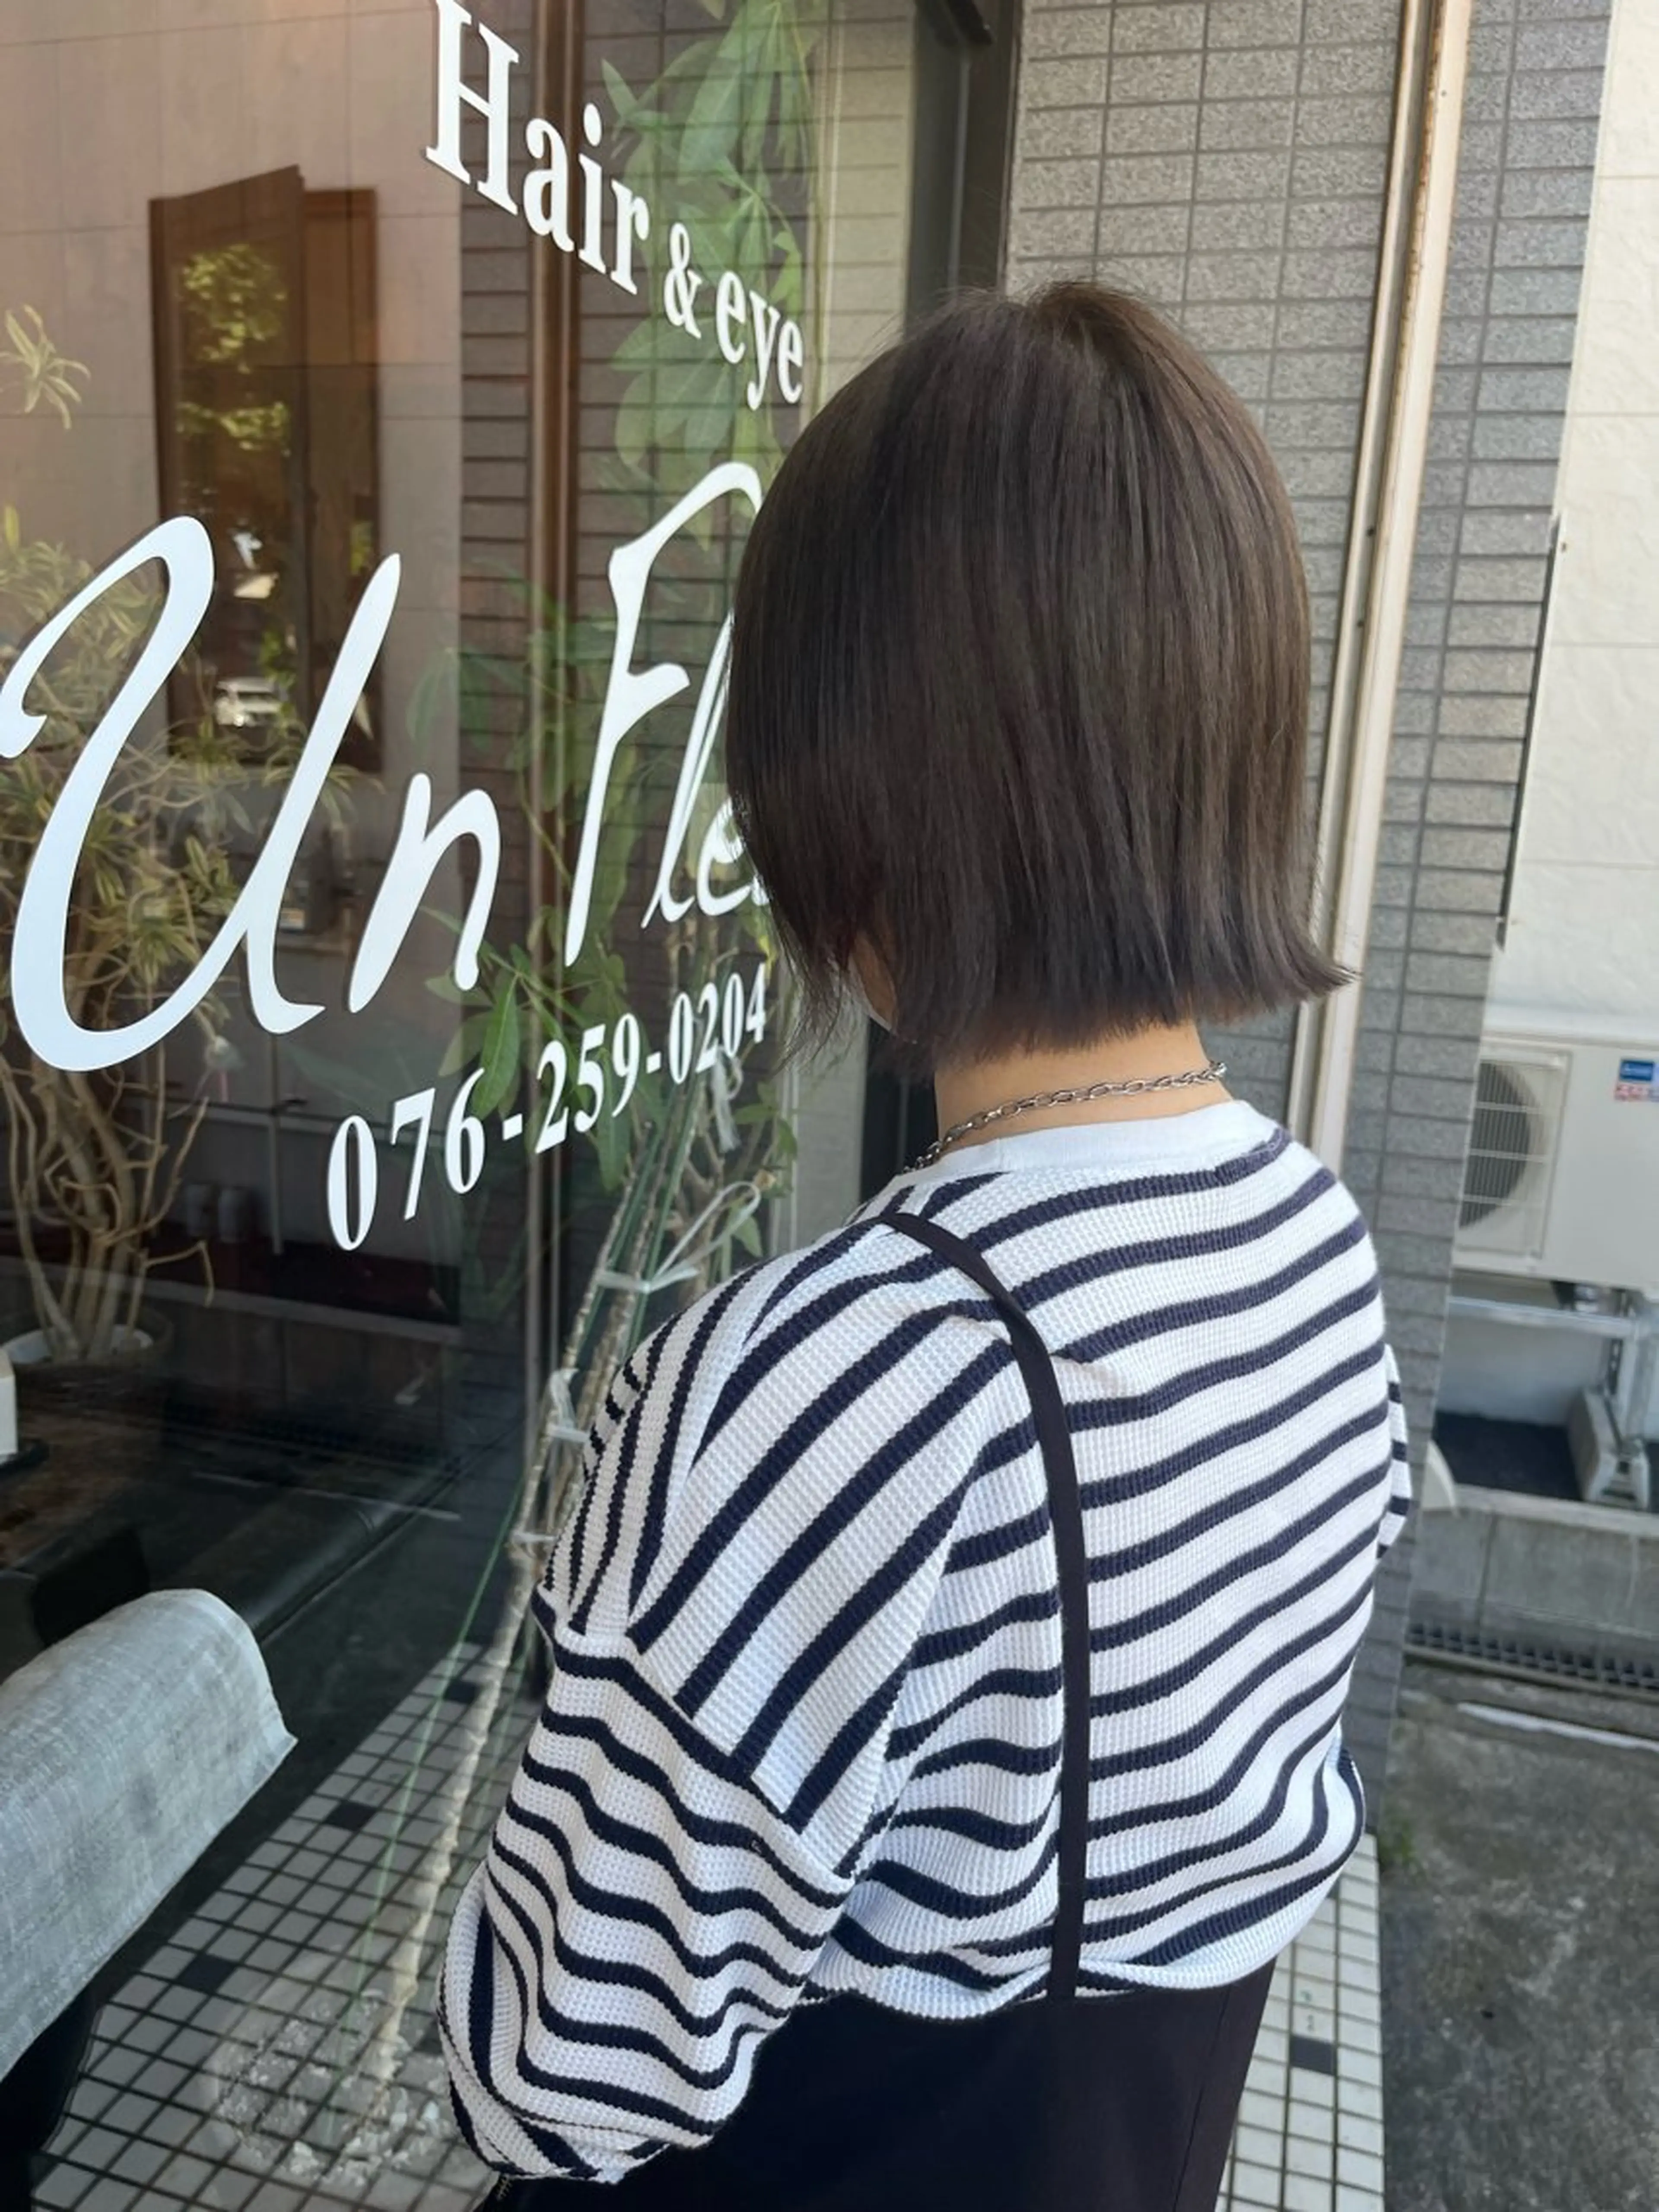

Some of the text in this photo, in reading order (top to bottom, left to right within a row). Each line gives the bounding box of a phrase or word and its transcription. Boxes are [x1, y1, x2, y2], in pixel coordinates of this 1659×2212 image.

[425, 0, 803, 411] Hair & eye
[0, 461, 772, 1071] Un Fle
[327, 962, 768, 1252] 076-259-0204
